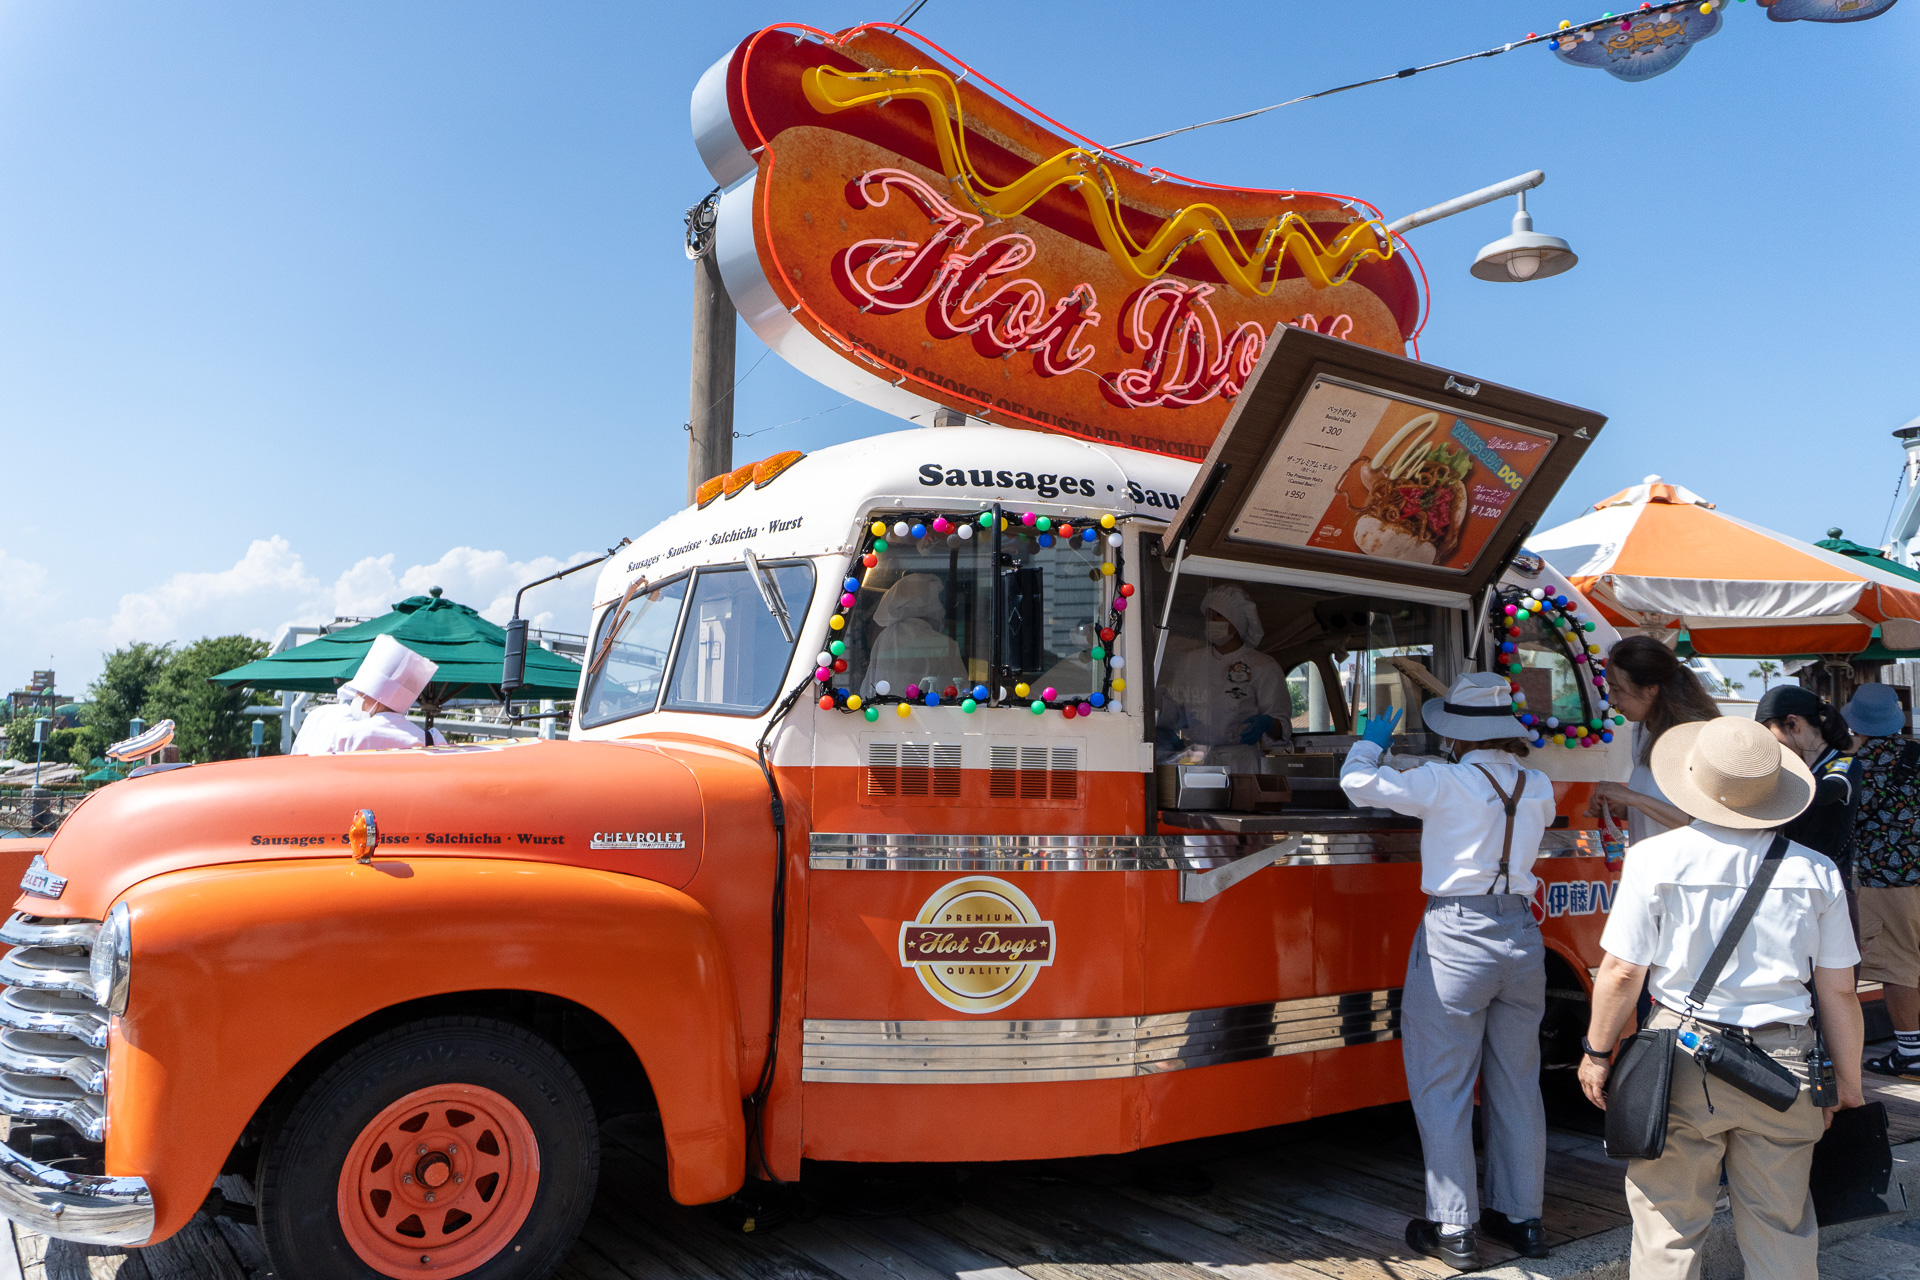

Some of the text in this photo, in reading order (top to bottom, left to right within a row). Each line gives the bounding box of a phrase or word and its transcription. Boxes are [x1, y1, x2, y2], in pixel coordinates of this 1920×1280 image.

[832, 167, 1354, 408] Hot Do
[1325, 414, 1340, 422] Bottled
[1327, 405, 1358, 418] ペットボトル
[1321, 425, 1343, 437] ¥300
[918, 463, 1096, 498] Sausages
[1497, 464, 1523, 490] DOG
[626, 515, 803, 573] Sausages Saucisse Salchicha Wurst
[251, 833, 565, 847] Sausages Sisse Salchicha Wurst
[593, 832, 683, 843] CHEVROLET
[946, 914, 1013, 922] PREMIUM
[919, 931, 1037, 961] Hot Dogs
[946, 967, 1011, 975] QUALITY
